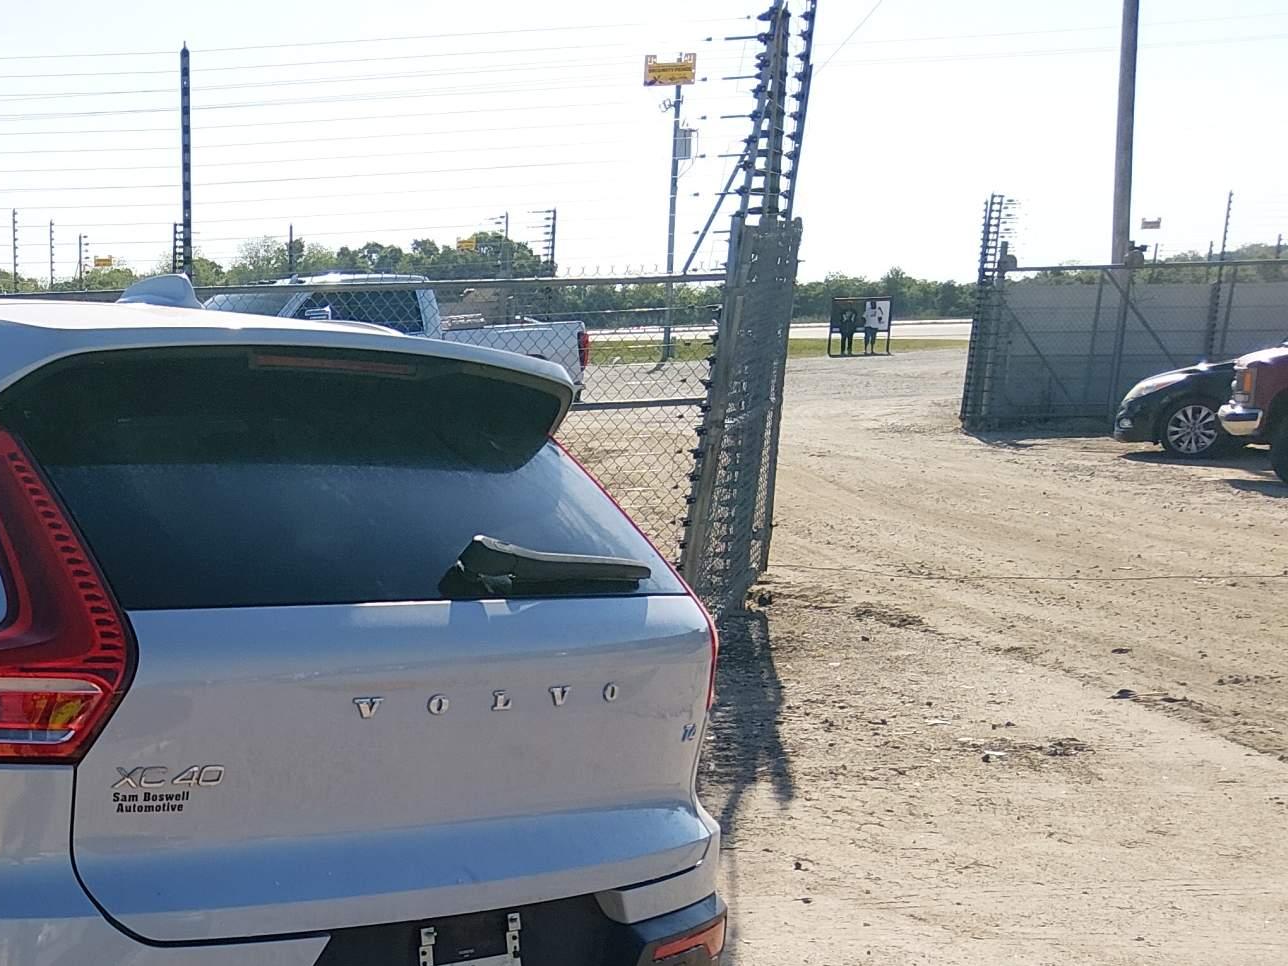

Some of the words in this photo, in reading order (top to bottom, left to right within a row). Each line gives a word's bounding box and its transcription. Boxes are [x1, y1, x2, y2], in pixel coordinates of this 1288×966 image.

[353, 682, 620, 719] VOLVO
[111, 764, 225, 788] XC40
[112, 791, 139, 803] Sam
[142, 790, 190, 803] Boswell
[116, 801, 184, 813] Automotive
